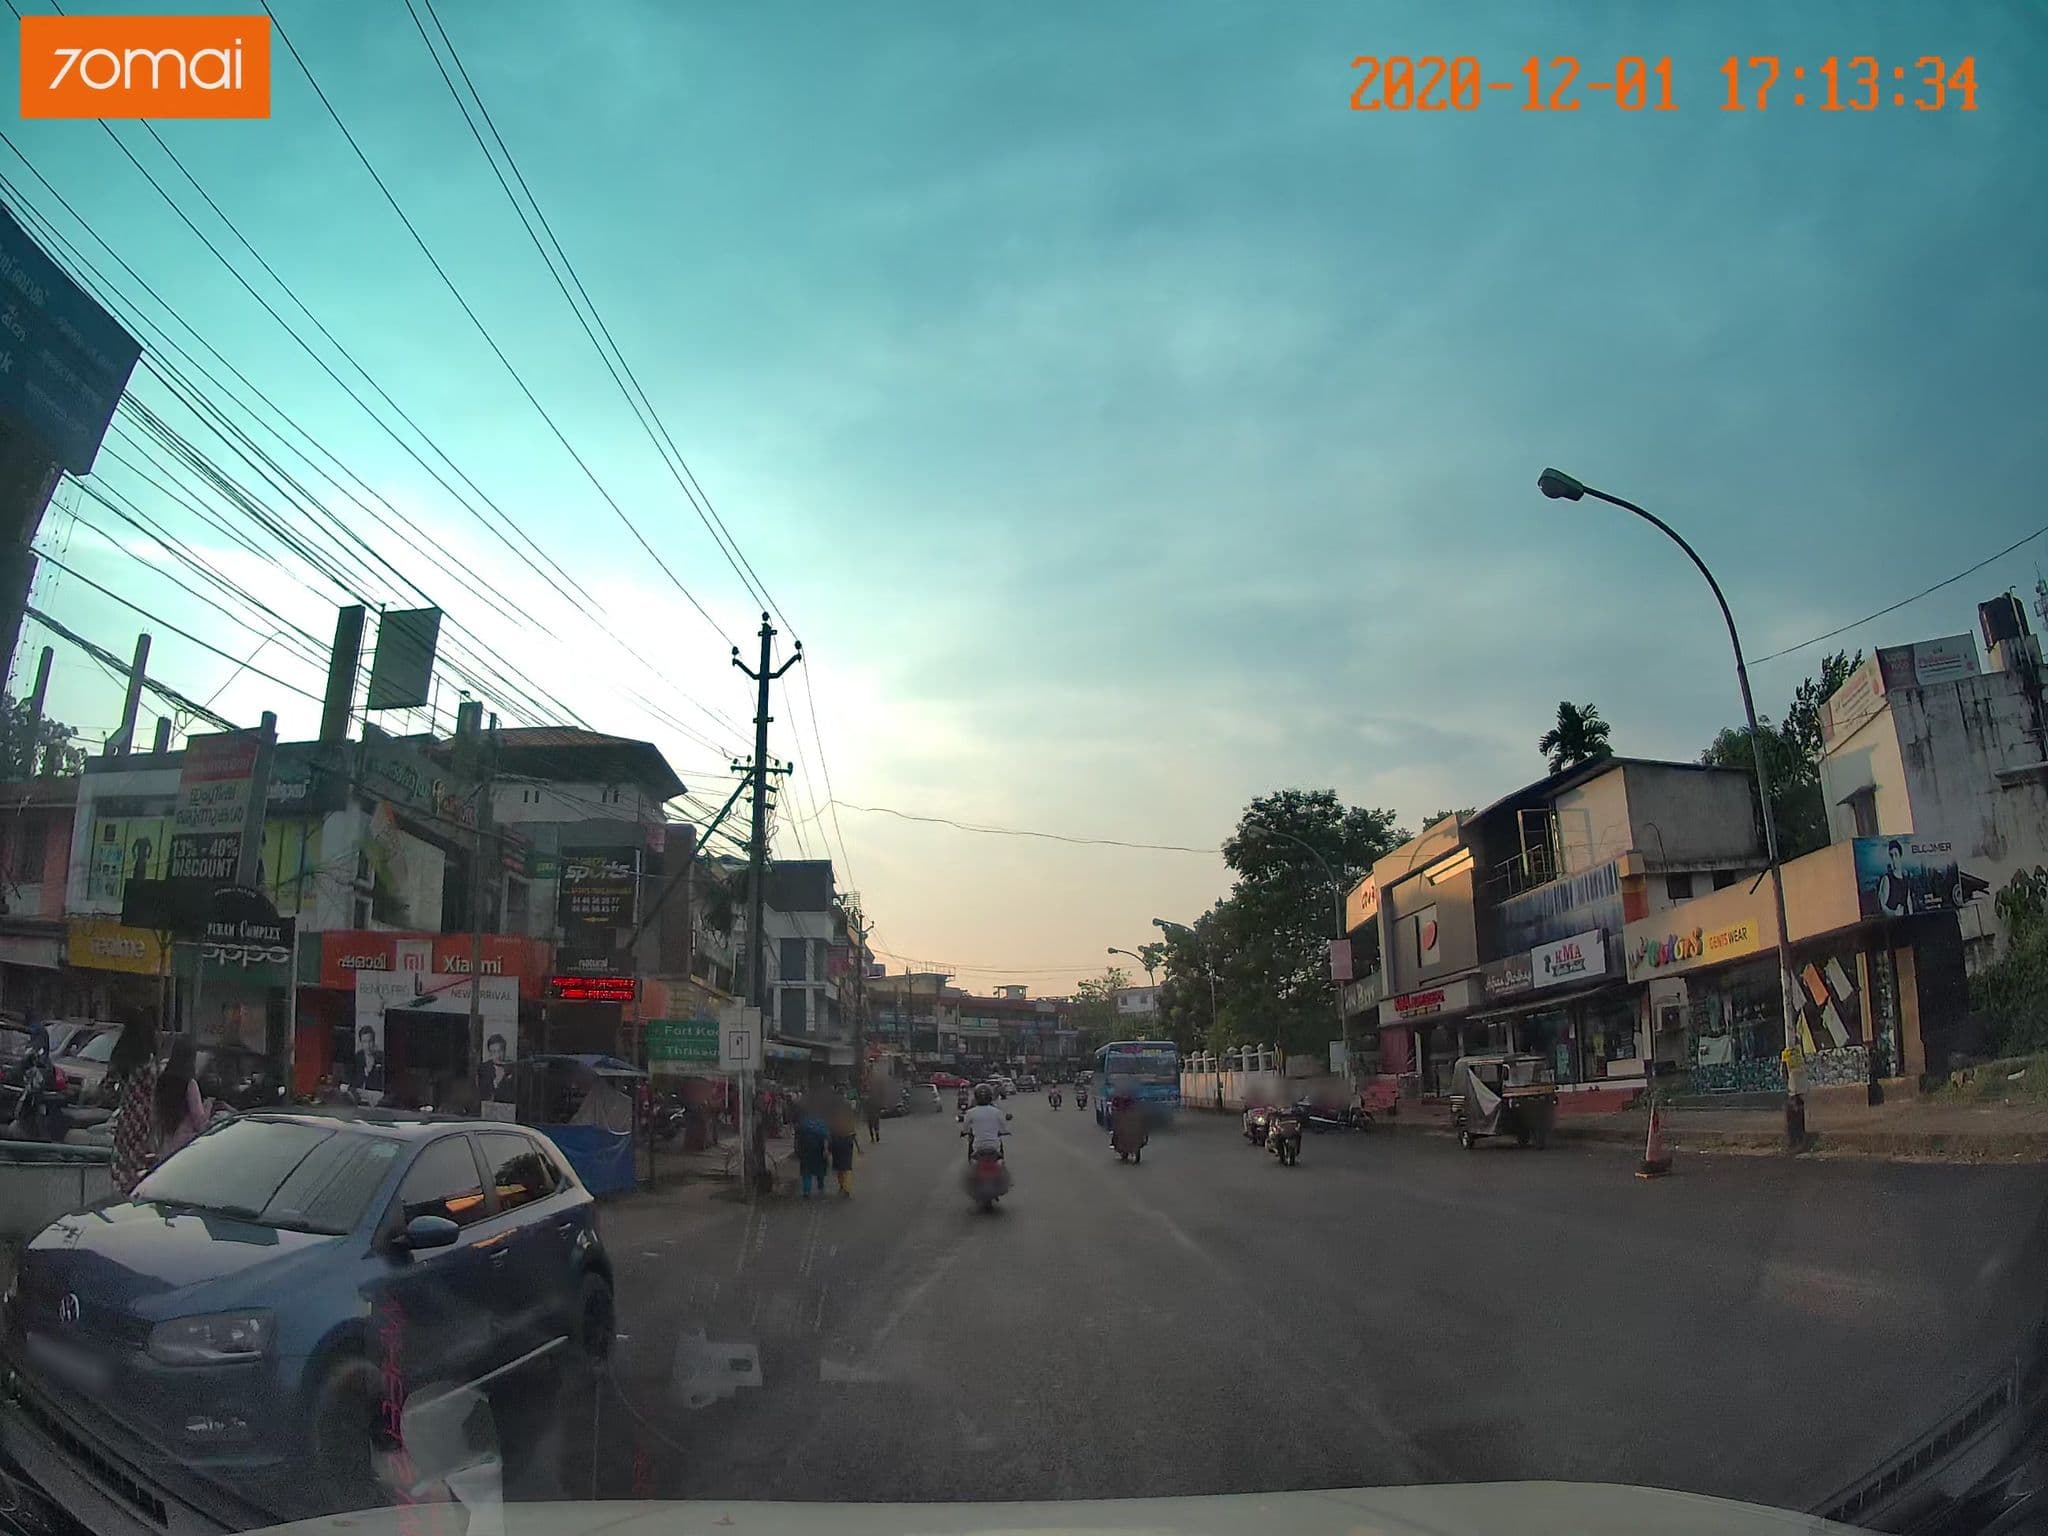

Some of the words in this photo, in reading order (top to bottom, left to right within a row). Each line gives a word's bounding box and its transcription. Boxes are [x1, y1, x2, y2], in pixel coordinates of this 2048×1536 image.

[209, 837, 239, 857] 40%
[172, 858, 235, 879] DISCOUNT
[443, 953, 503, 974] Xiami
[664, 1025, 691, 1036] Fort
